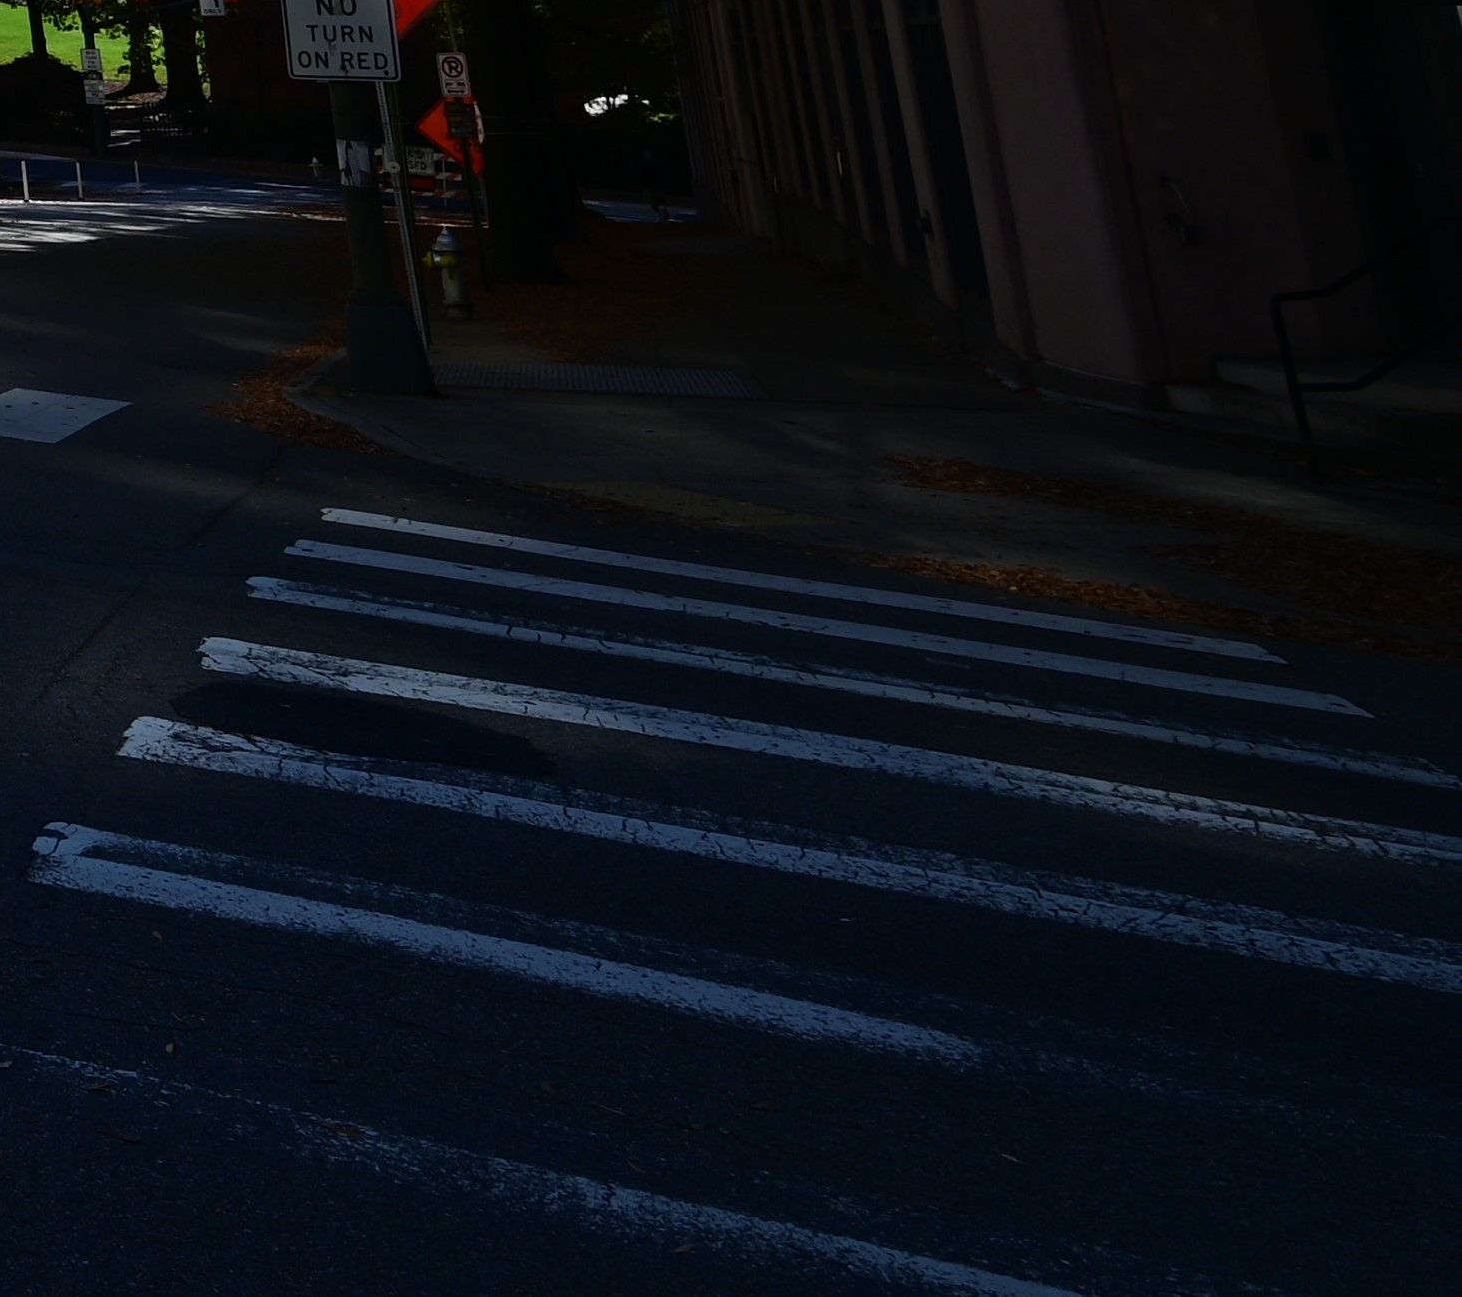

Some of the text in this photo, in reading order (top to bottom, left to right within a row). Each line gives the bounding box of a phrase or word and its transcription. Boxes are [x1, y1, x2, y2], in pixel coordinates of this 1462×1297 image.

[306, 25, 373, 43] TURN
[298, 51, 389, 71] ON RED
